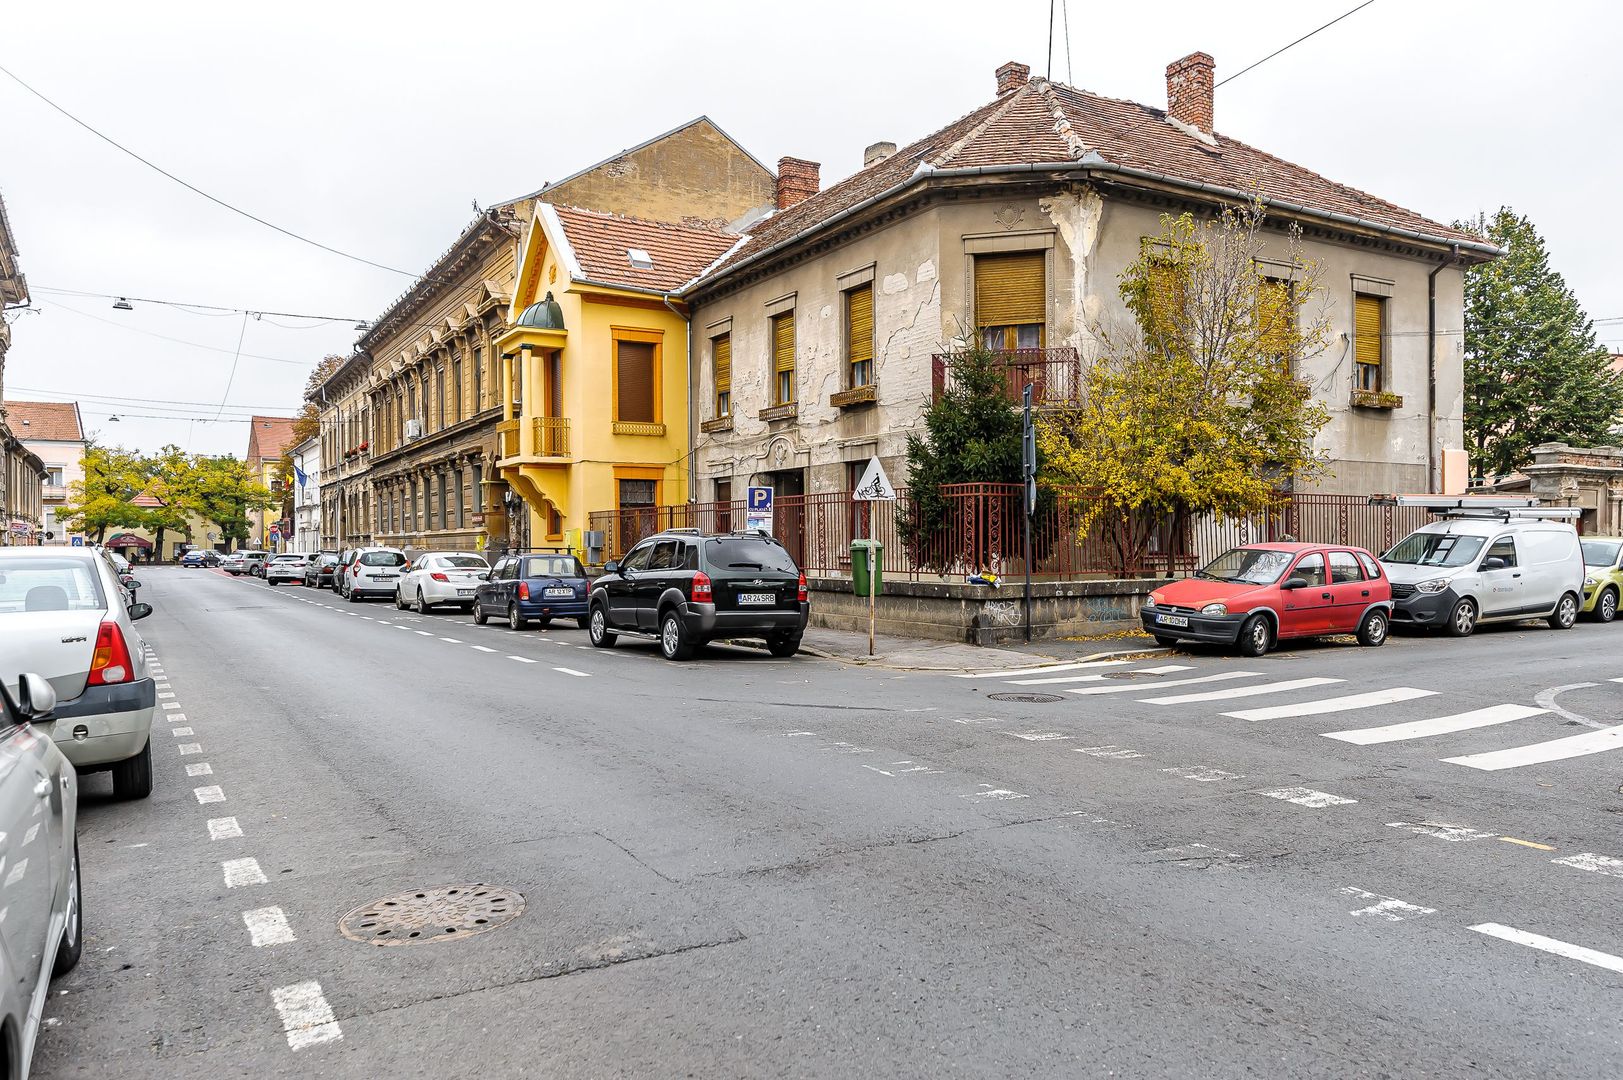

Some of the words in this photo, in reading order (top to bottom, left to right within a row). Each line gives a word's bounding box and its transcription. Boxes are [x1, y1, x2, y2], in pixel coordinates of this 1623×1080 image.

[754, 489, 767, 507] P
[742, 594, 752, 602] AR
[753, 594, 761, 602] 24
[761, 594, 775, 602] SRB
[1159, 614, 1168, 623] AR
